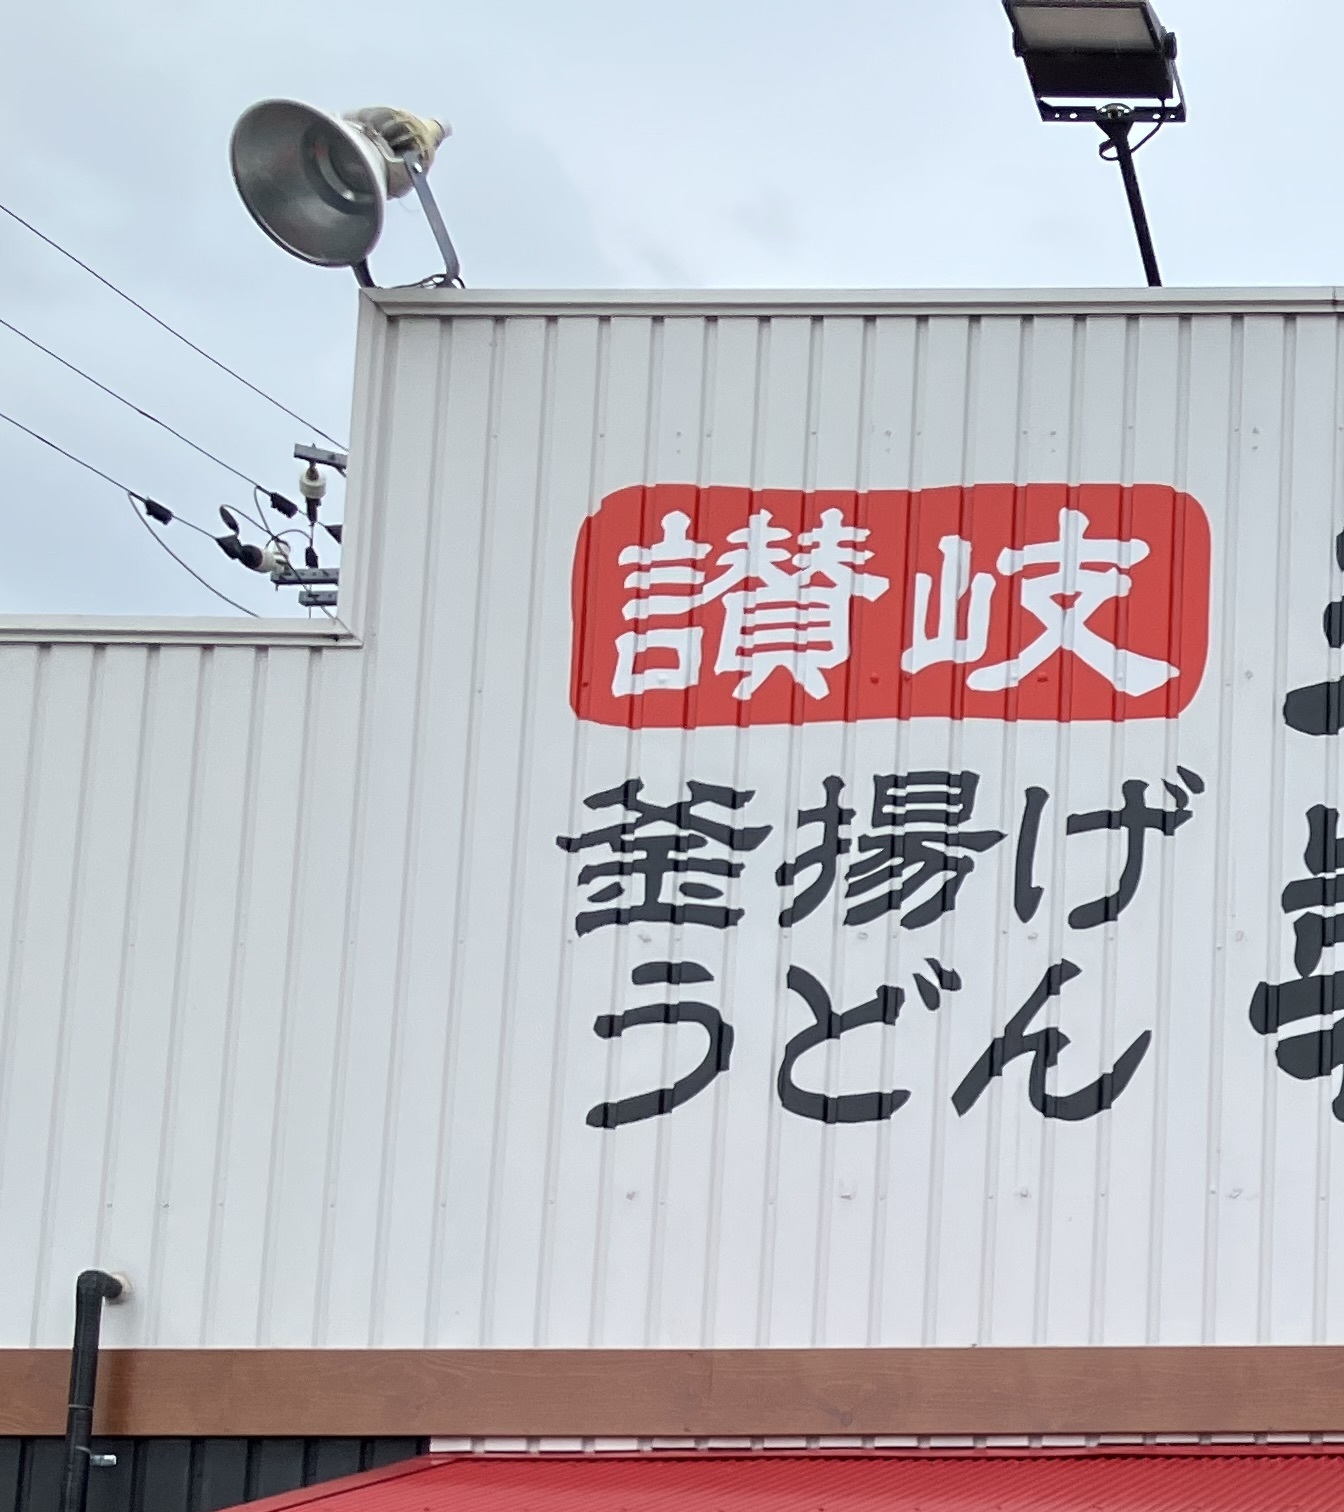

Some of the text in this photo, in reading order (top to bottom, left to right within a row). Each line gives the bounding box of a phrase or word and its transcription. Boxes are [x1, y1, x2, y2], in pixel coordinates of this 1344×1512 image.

[612, 508, 1180, 700] 讃岐
[556, 765, 1206, 938] 釜揚げ
[586, 957, 1152, 1130] うどん
